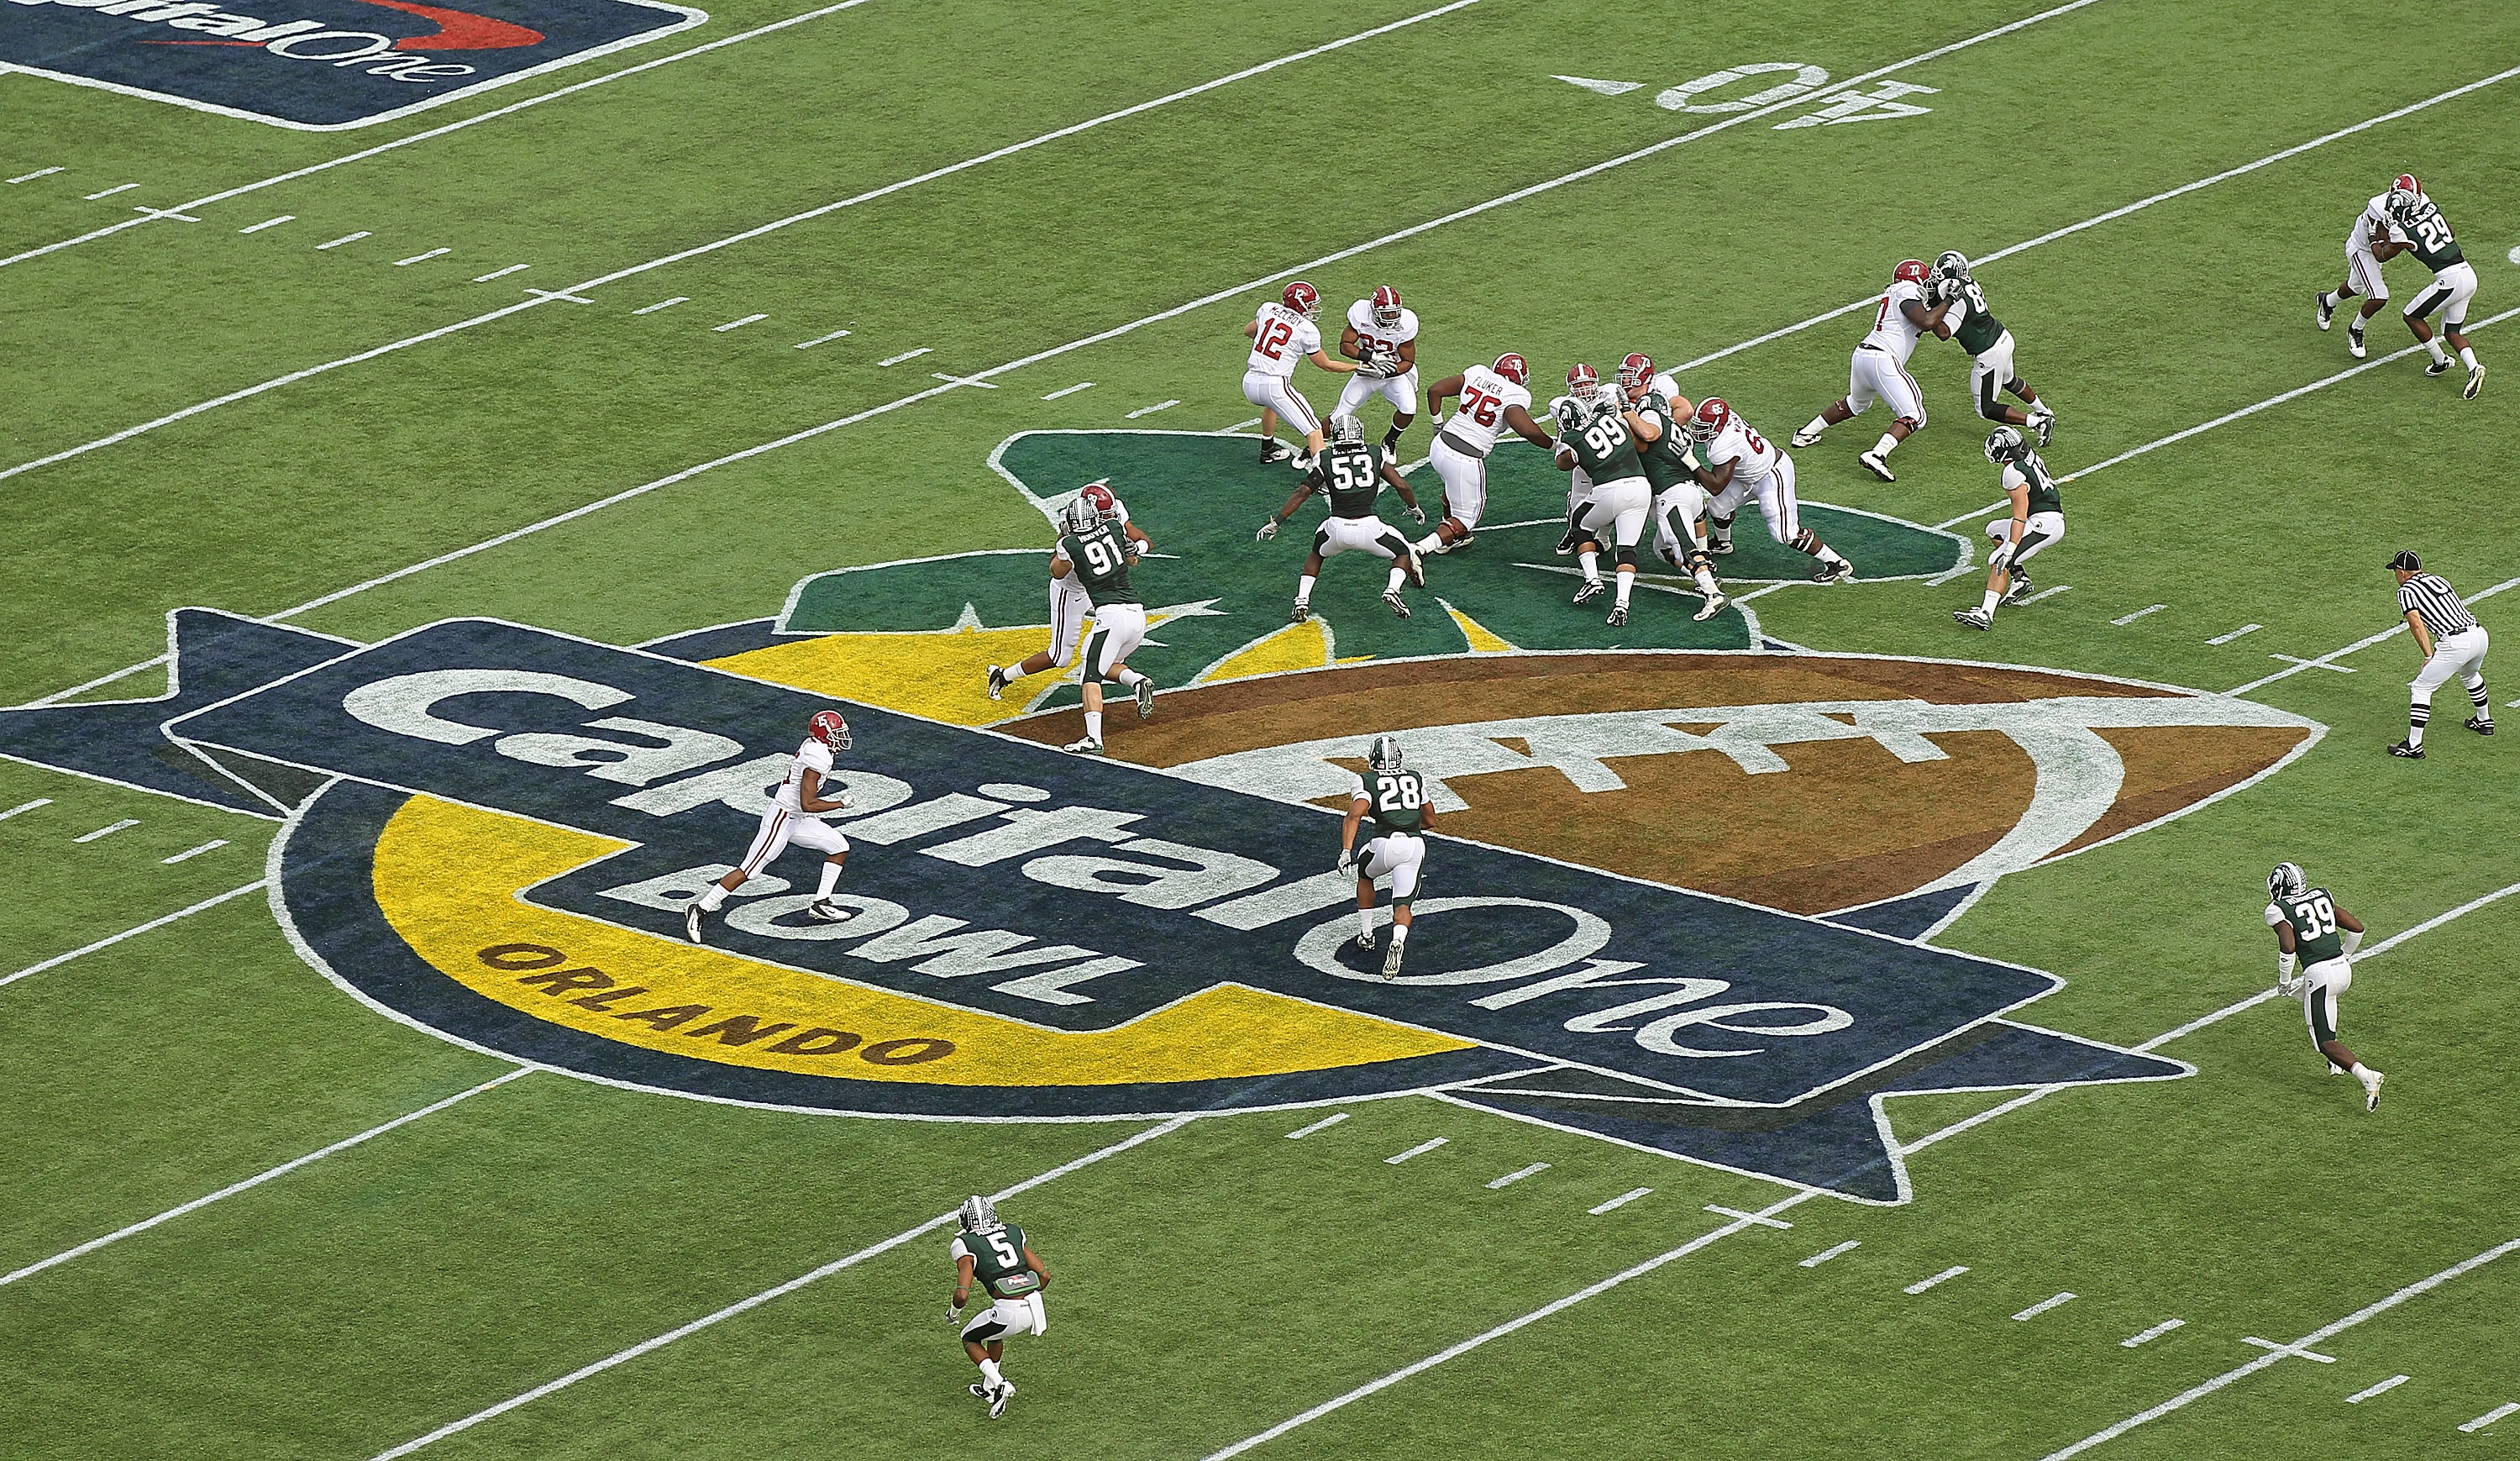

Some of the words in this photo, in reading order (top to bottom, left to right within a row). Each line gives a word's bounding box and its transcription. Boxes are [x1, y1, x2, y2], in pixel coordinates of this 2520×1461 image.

[2417, 213, 2454, 255] 29
[1254, 317, 1293, 361] 12
[1459, 385, 1502, 428] 76
[1473, 376, 1504, 396] FLUKER
[1584, 413, 1627, 460] 99
[1331, 454, 1374, 490] 53
[1077, 524, 1110, 544] HOOVER
[1084, 533, 1125, 576] 91
[817, 715, 827, 728] 15
[1376, 775, 1420, 812] 28
[596, 864, 1146, 1007] BOWL
[2294, 896, 2336, 942] 39
[477, 942, 957, 1066] ORLANDO
[986, 1231, 1020, 1269] 5
